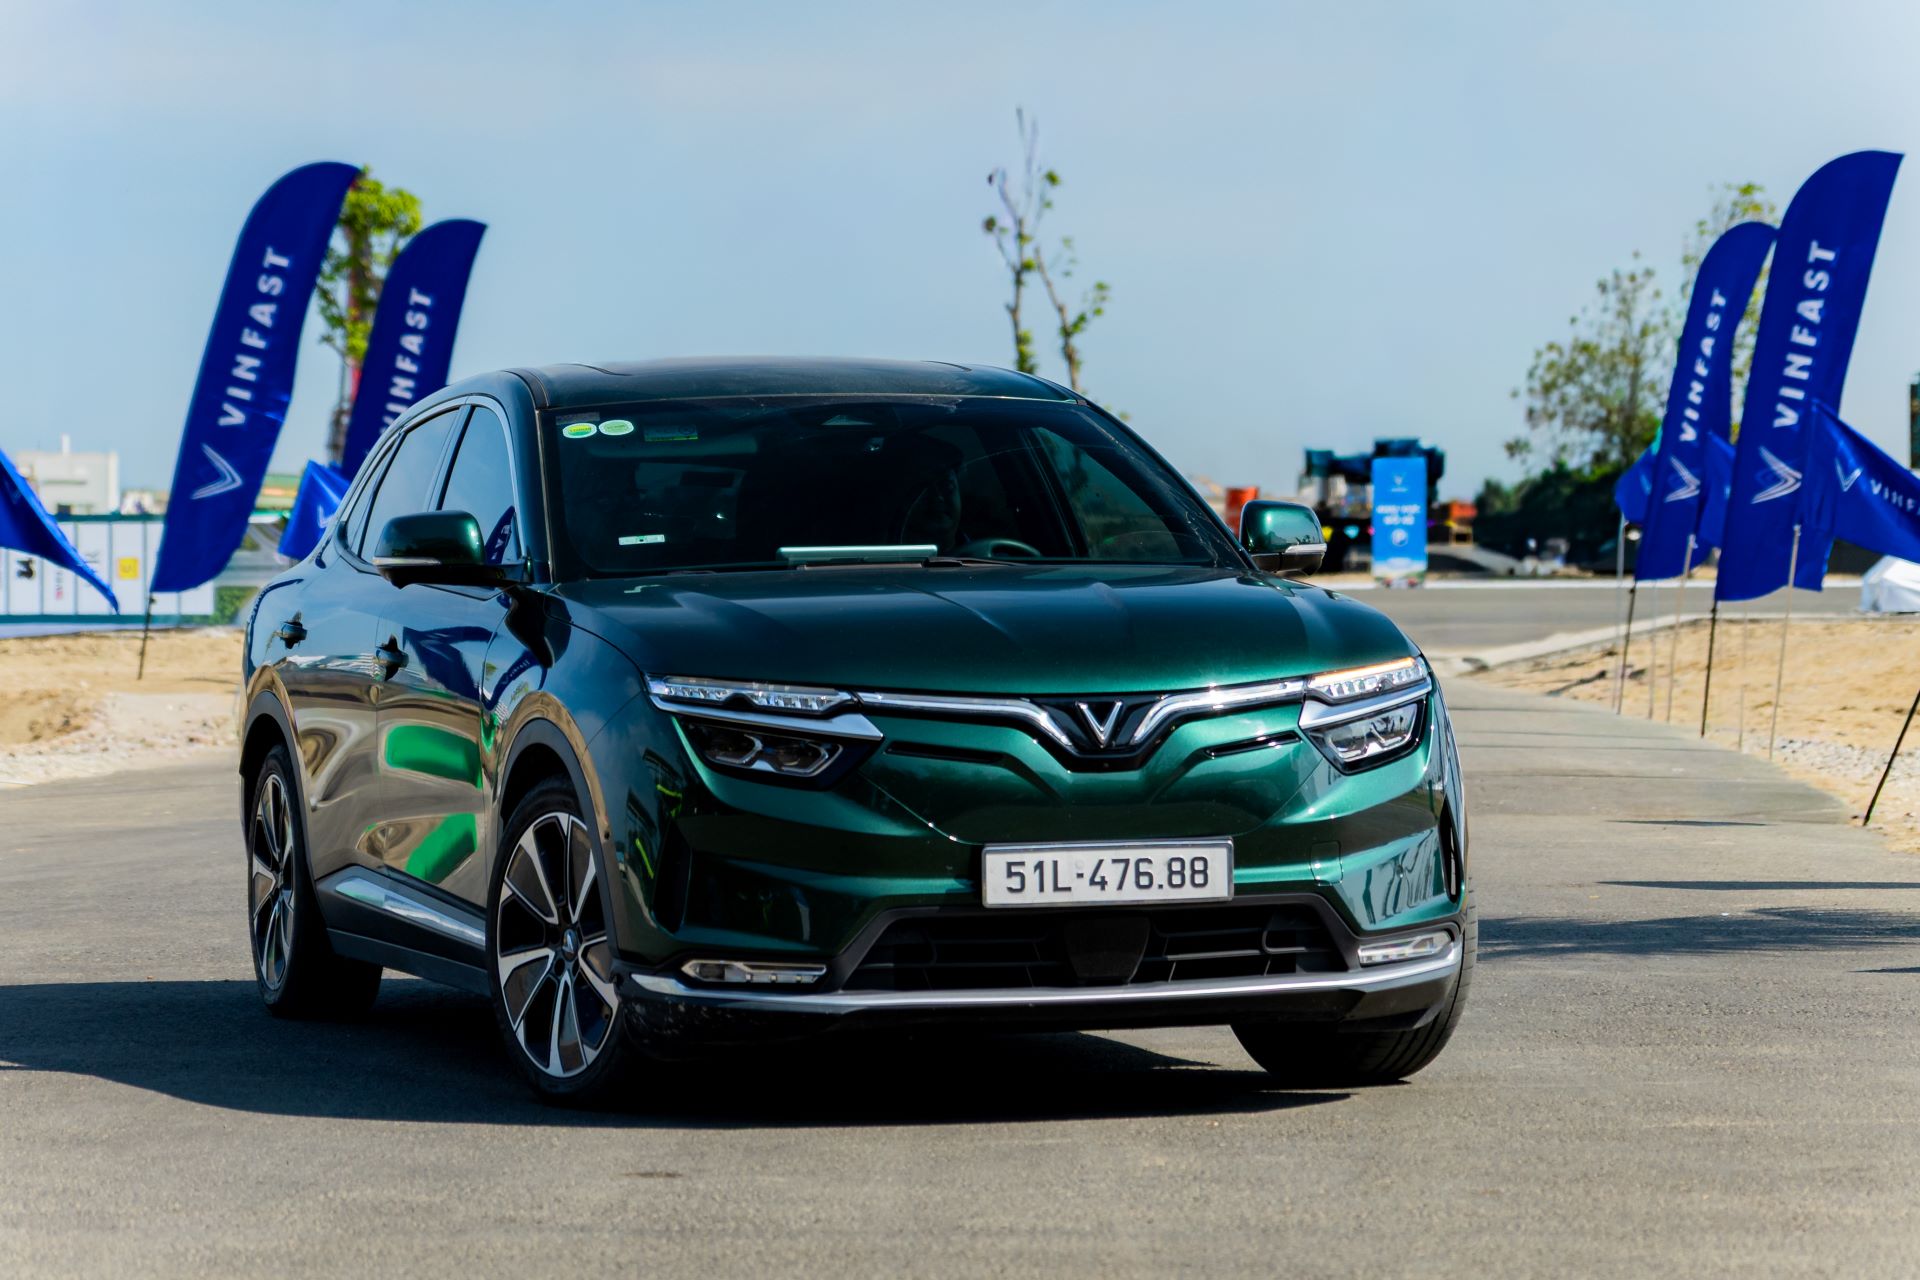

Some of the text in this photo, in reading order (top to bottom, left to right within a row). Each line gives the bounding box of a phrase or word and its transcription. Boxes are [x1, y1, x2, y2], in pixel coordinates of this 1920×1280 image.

[217, 247, 290, 426] VINFAST
[1679, 287, 1726, 441] VINFAST
[1773, 240, 1836, 428] VINFAST
[1006, 856, 1209, 893] 51L-476.88
